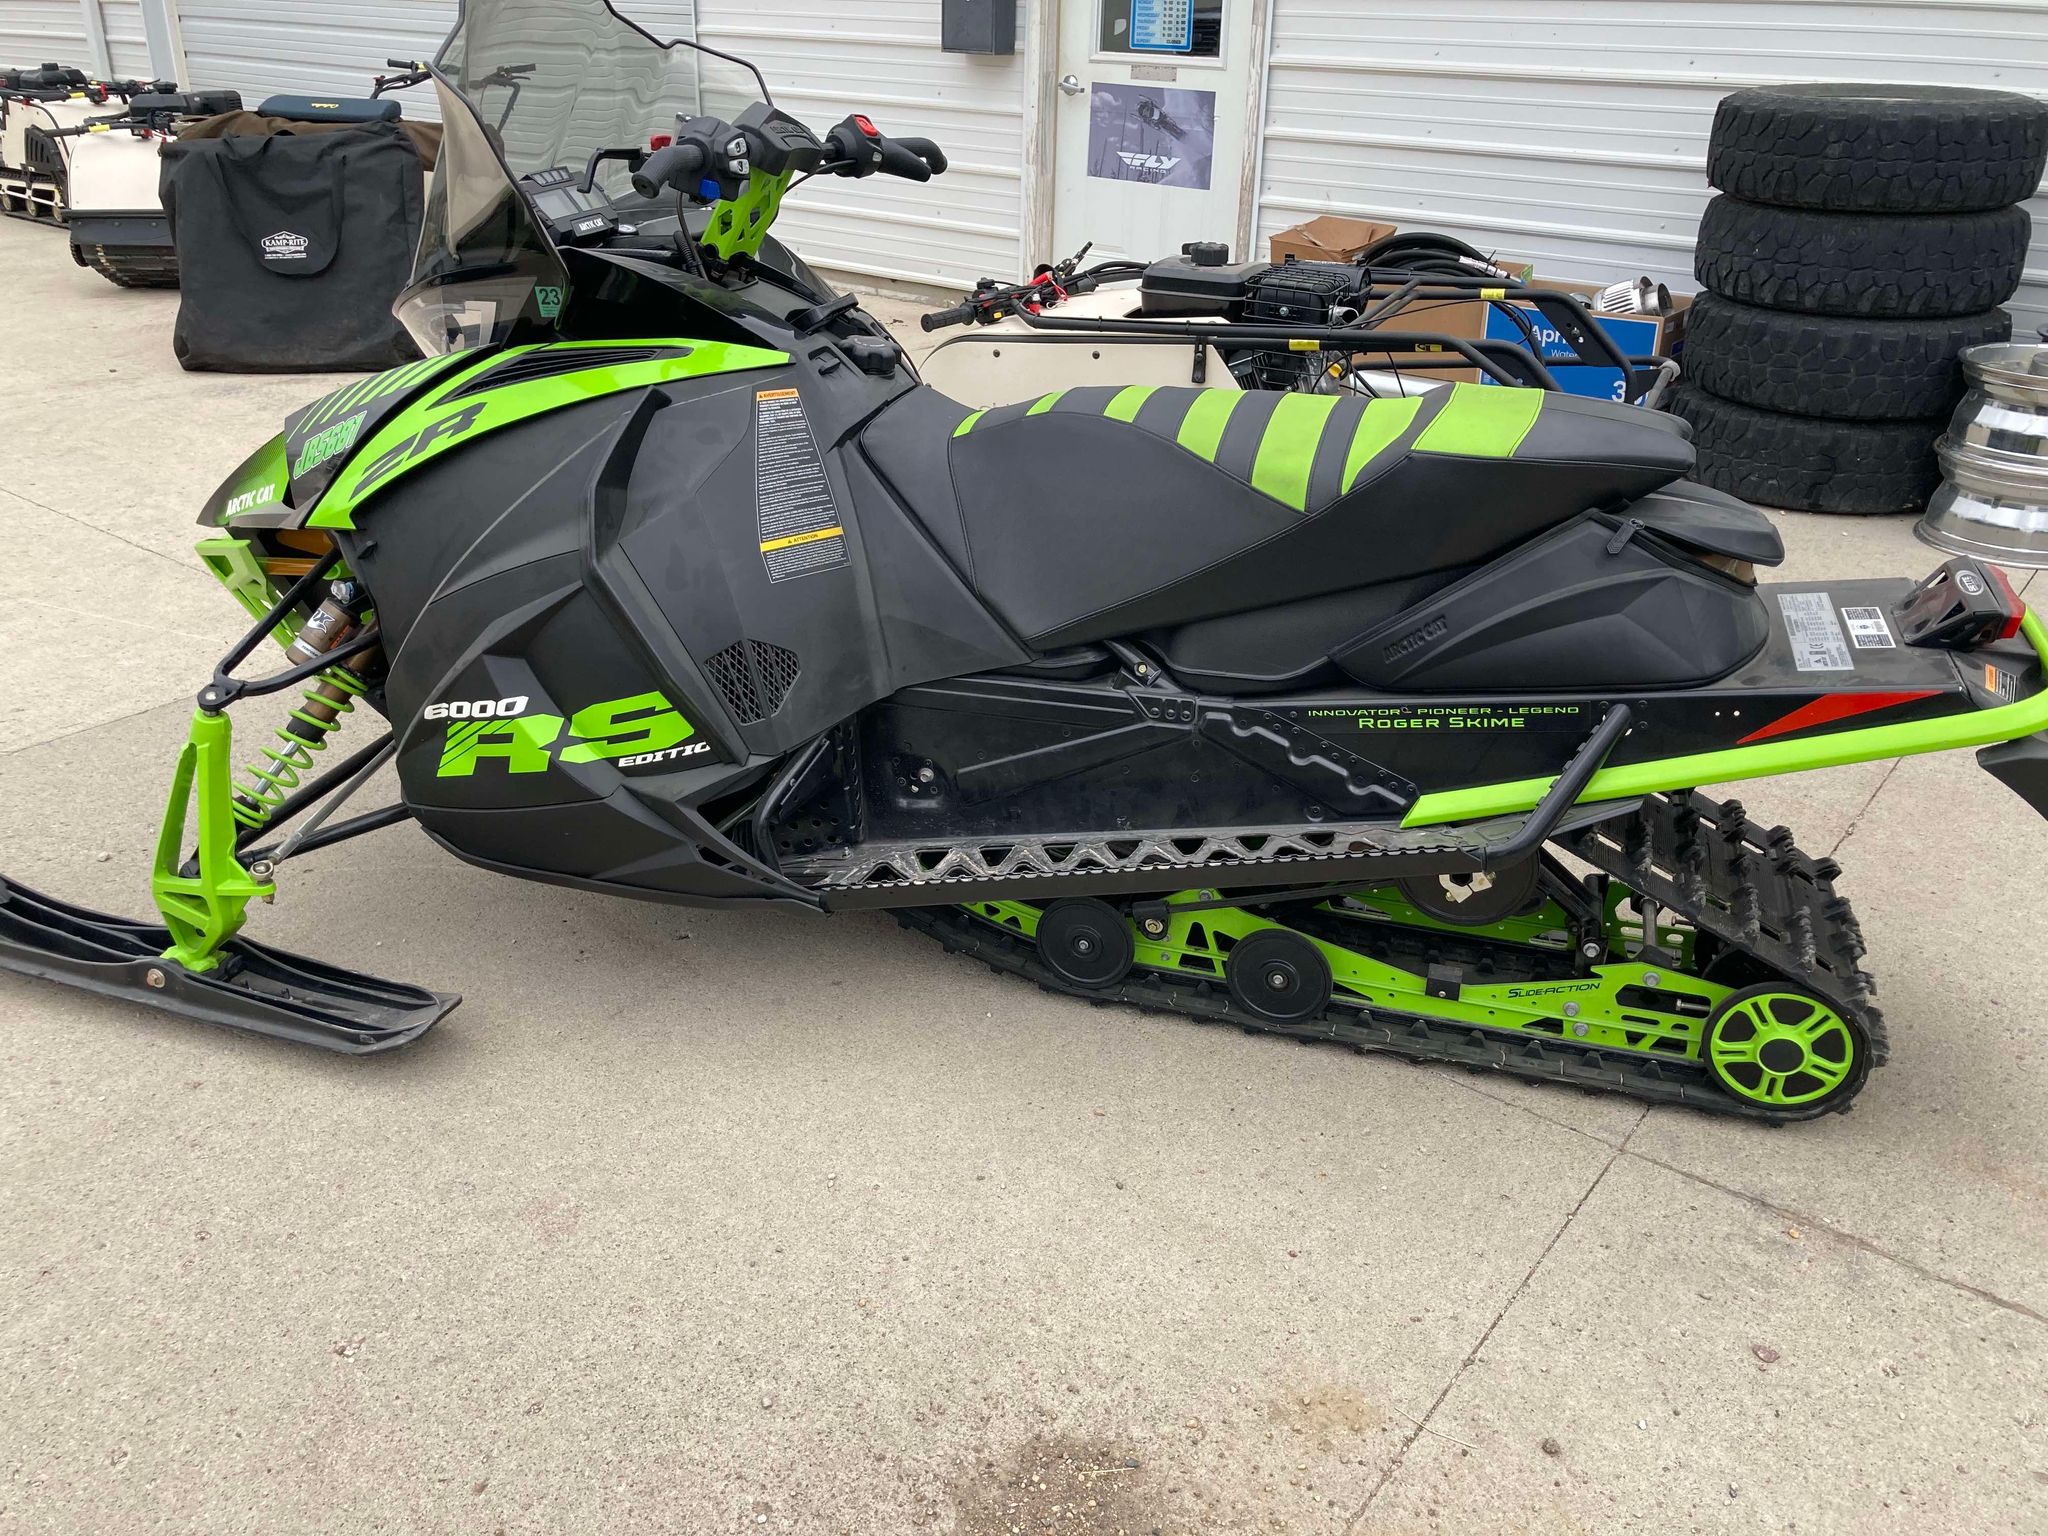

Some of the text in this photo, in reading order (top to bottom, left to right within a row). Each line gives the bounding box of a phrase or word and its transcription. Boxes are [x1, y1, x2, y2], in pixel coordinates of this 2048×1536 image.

[1116, 151, 1181, 170] FLY
[1129, 165, 1167, 174] RACING
[539, 287, 561, 306] 23
[348, 401, 488, 503] ZR
[225, 483, 276, 518] ARCTIC CAT
[423, 695, 530, 720] 6000
[1308, 709, 1401, 717] INNOVATOR
[1417, 707, 1491, 715] PIONEER
[1509, 706, 1579, 714] LEGEND
